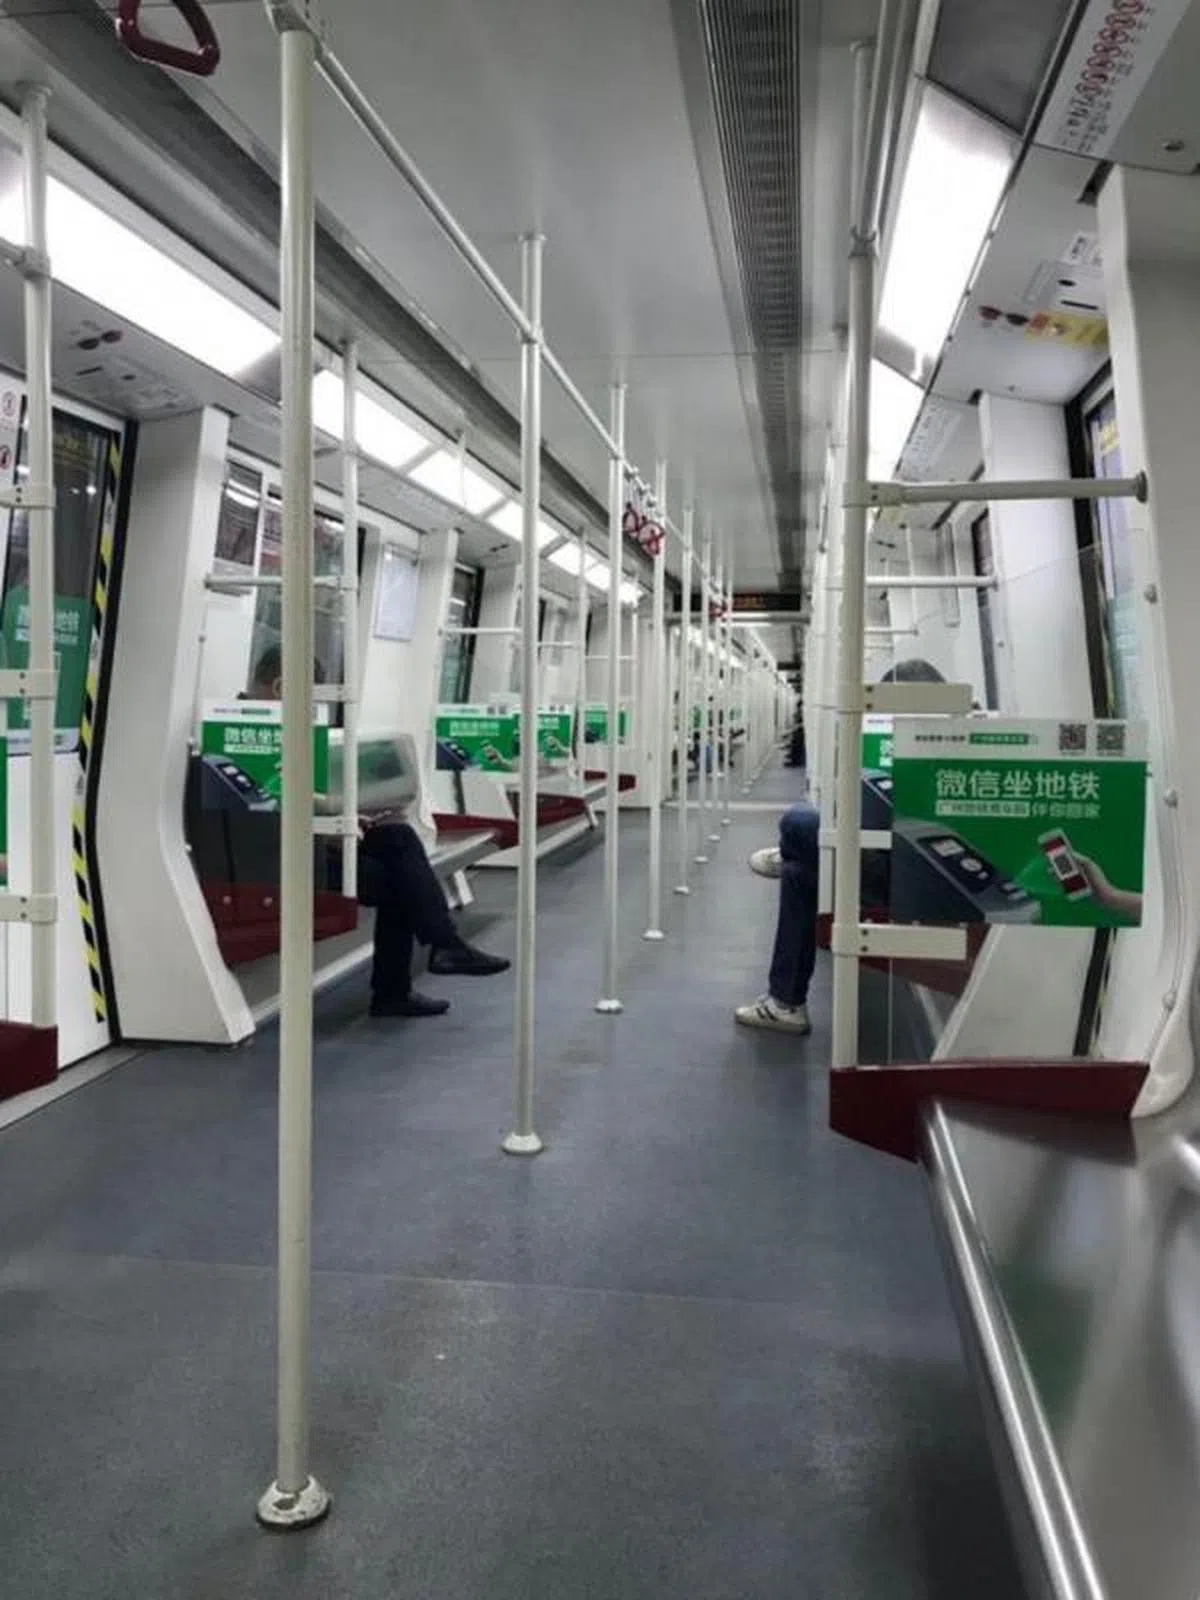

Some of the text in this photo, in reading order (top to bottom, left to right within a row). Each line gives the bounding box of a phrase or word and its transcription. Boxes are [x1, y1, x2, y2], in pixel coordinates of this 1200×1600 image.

[936, 769, 1099, 799] 微信坐地铁
